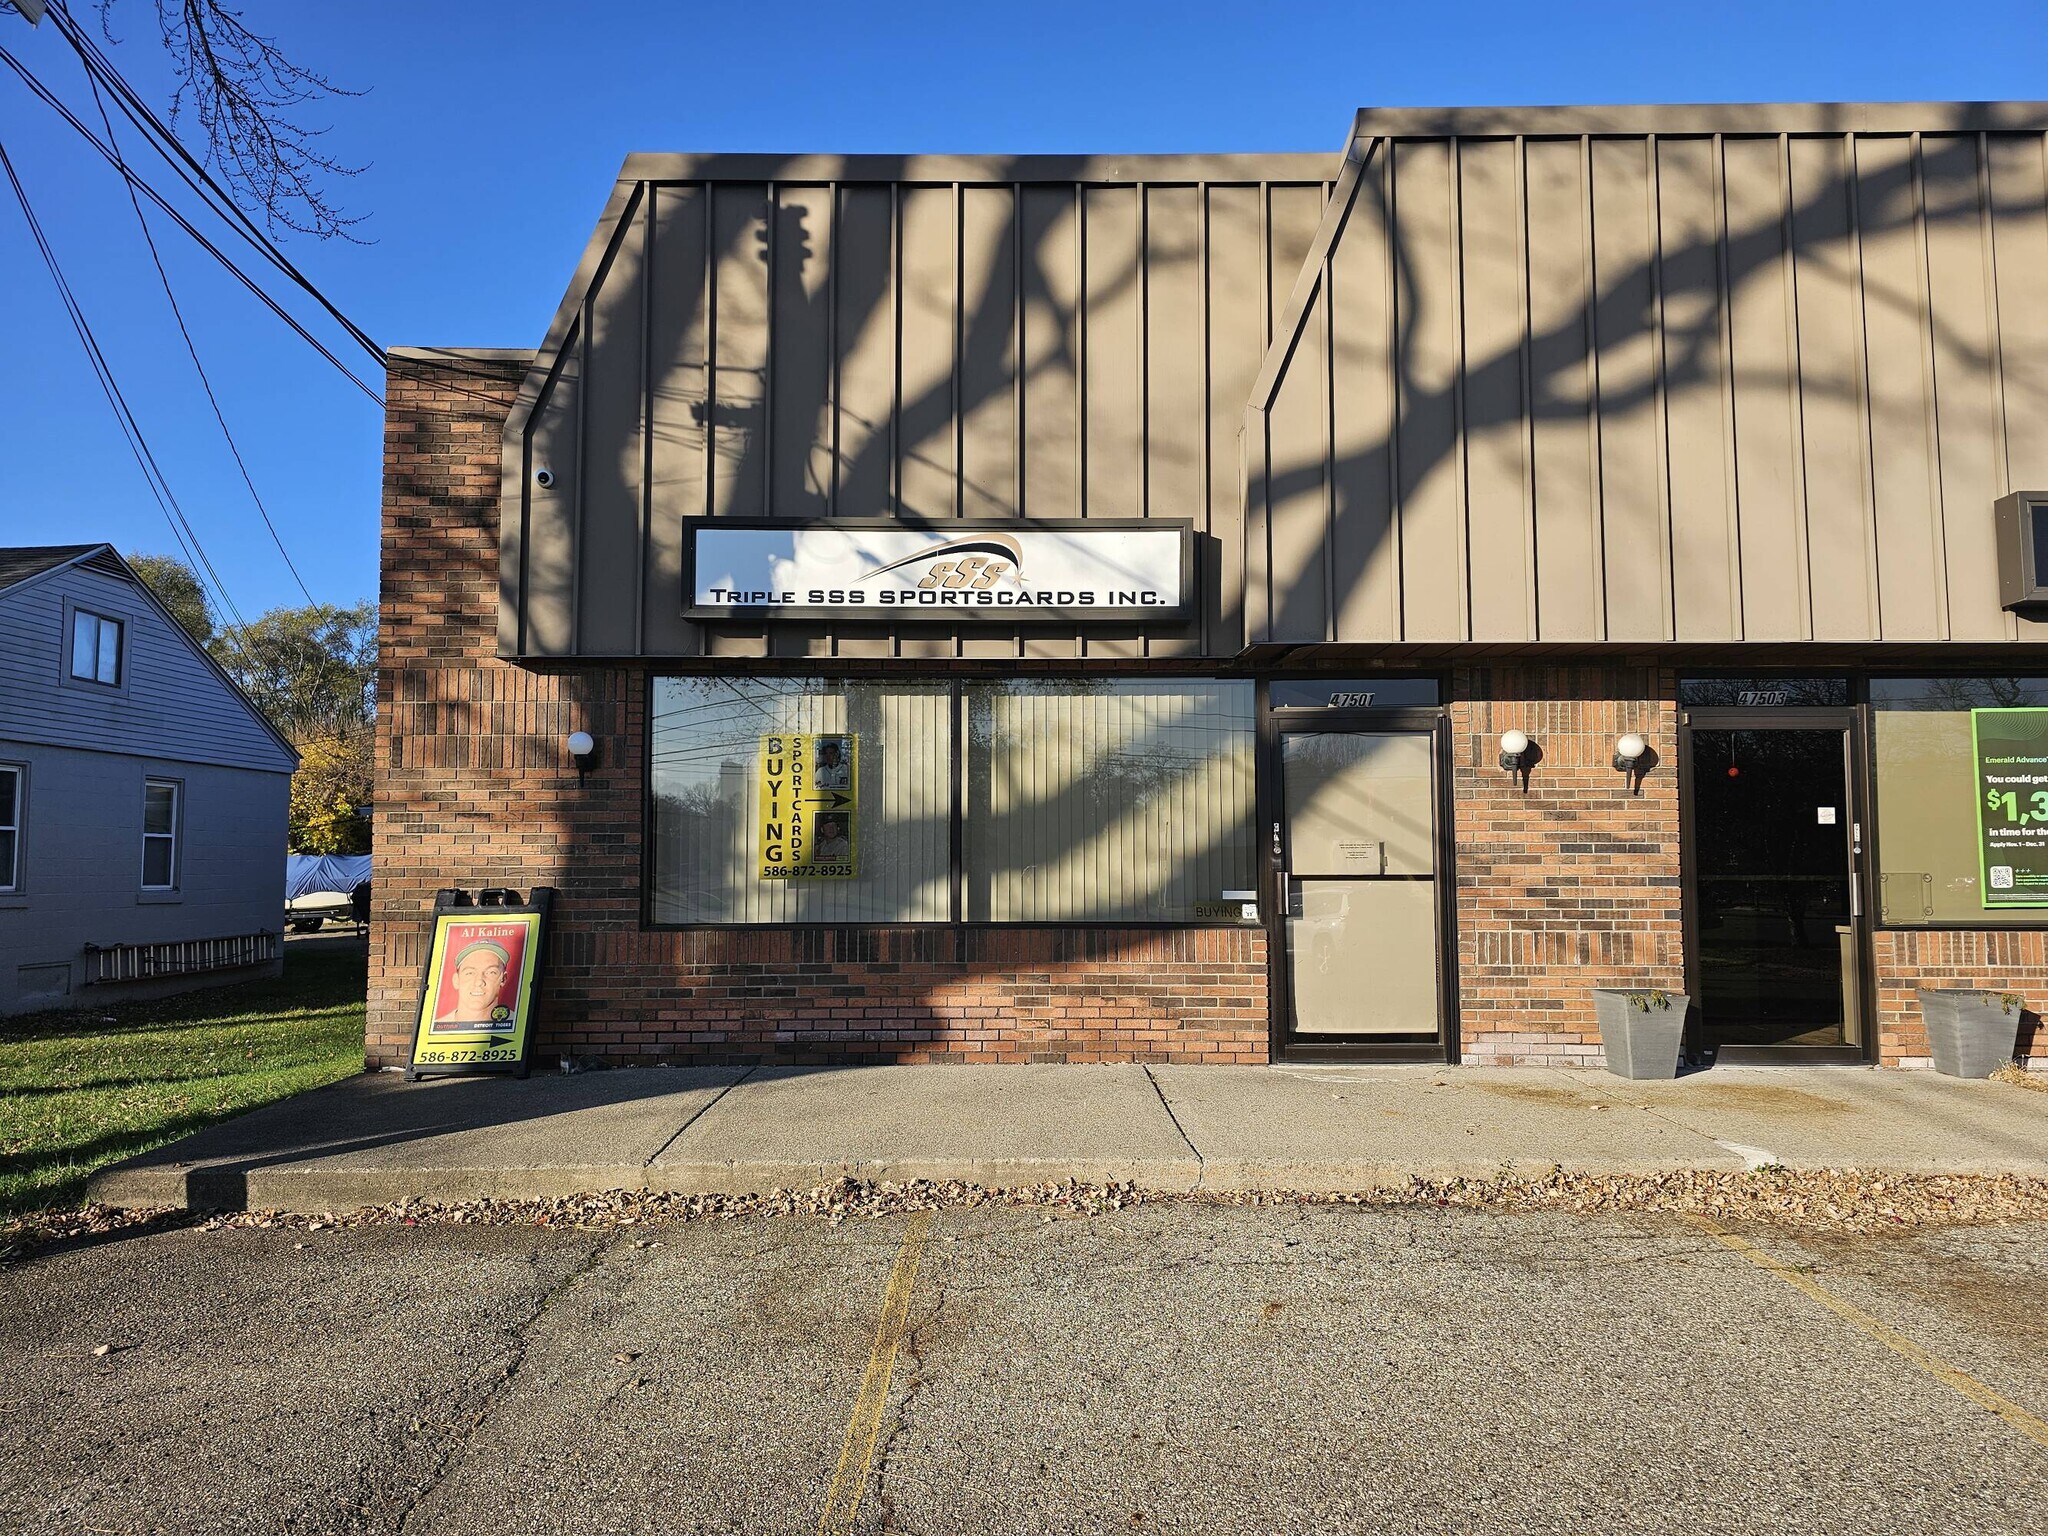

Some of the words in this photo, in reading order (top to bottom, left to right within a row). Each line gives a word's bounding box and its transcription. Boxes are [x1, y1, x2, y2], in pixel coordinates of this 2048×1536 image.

[917, 557, 1011, 589] SSS
[808, 590, 865, 604] SSS
[879, 590, 1096, 605] SPORTSCARDS
[1108, 590, 1167, 605] INC.
[1329, 693, 1375, 707] 47501
[1738, 692, 1788, 706] 47503
[1985, 756, 2015, 764] Emerald
[1985, 775, 2004, 783] You
[2004, 774, 2031, 783] could
[2032, 775, 2048, 784] get
[765, 737, 783, 862] BUYING
[791, 737, 803, 861] SPORTCARDS
[1999, 827, 2021, 836] time
[2021, 827, 2035, 836] for
[763, 865, 852, 877] 586-872-8925
[1196, 906, 1242, 918] BUYING
[461, 927, 475, 938] Al
[478, 926, 515, 937] Kaline
[419, 1050, 517, 1063] 586-872-8925
